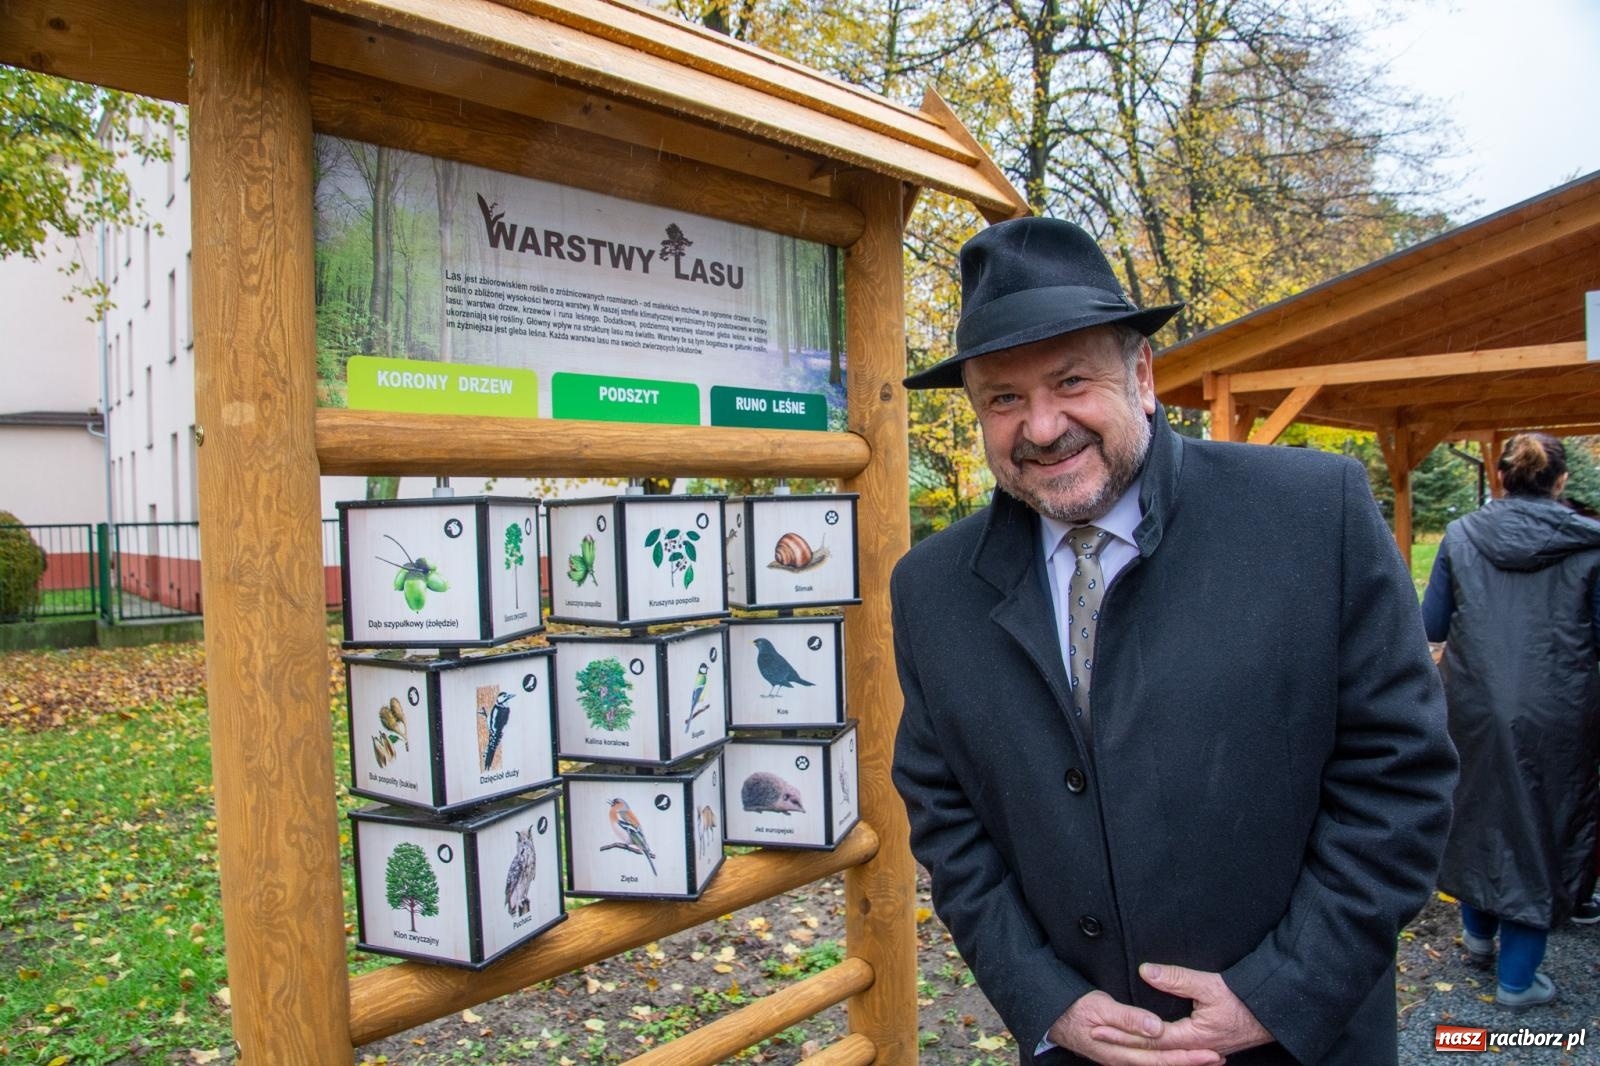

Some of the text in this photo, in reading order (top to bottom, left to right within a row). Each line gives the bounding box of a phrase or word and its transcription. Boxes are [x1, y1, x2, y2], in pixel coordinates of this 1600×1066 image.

[482, 204, 744, 290] WARSTWY LASU
[446, 269, 462, 281] Las
[465, 275, 478, 284] jest
[479, 278, 528, 291] zbiorowiskiem
[530, 284, 548, 294] roślin
[556, 288, 605, 302] zróżnicowanych
[446, 284, 467, 294] roślin
[475, 288, 505, 301] zbliżonej
[507, 294, 542, 305] wysokości
[543, 298, 565, 308] tworzą
[601, 306, 619, 316] naszej
[467, 301, 496, 310] warstwa
[523, 305, 551, 317] krzewów
[447, 308, 487, 322] ukorzeniają
[489, 313, 500, 324] się
[553, 320, 573, 332] wpływ
[574, 323, 582, 331] na
[447, 320, 455, 328] im
[495, 325, 508, 335] jest
[509, 327, 527, 337] gleba
[550, 331, 569, 341] Każda
[571, 333, 596, 343] warstwa
[377, 370, 513, 394] KORONY DRZEW
[599, 385, 660, 405] PODSZYT
[735, 396, 806, 415] RUNO LEŚNE
[368, 618, 459, 632] Dąb szypułkowy (żołędzie)
[480, 768, 520, 785] Dzięcioł duży
[620, 874, 639, 884] Zięba
[393, 930, 440, 947] Klon zwyczajny
